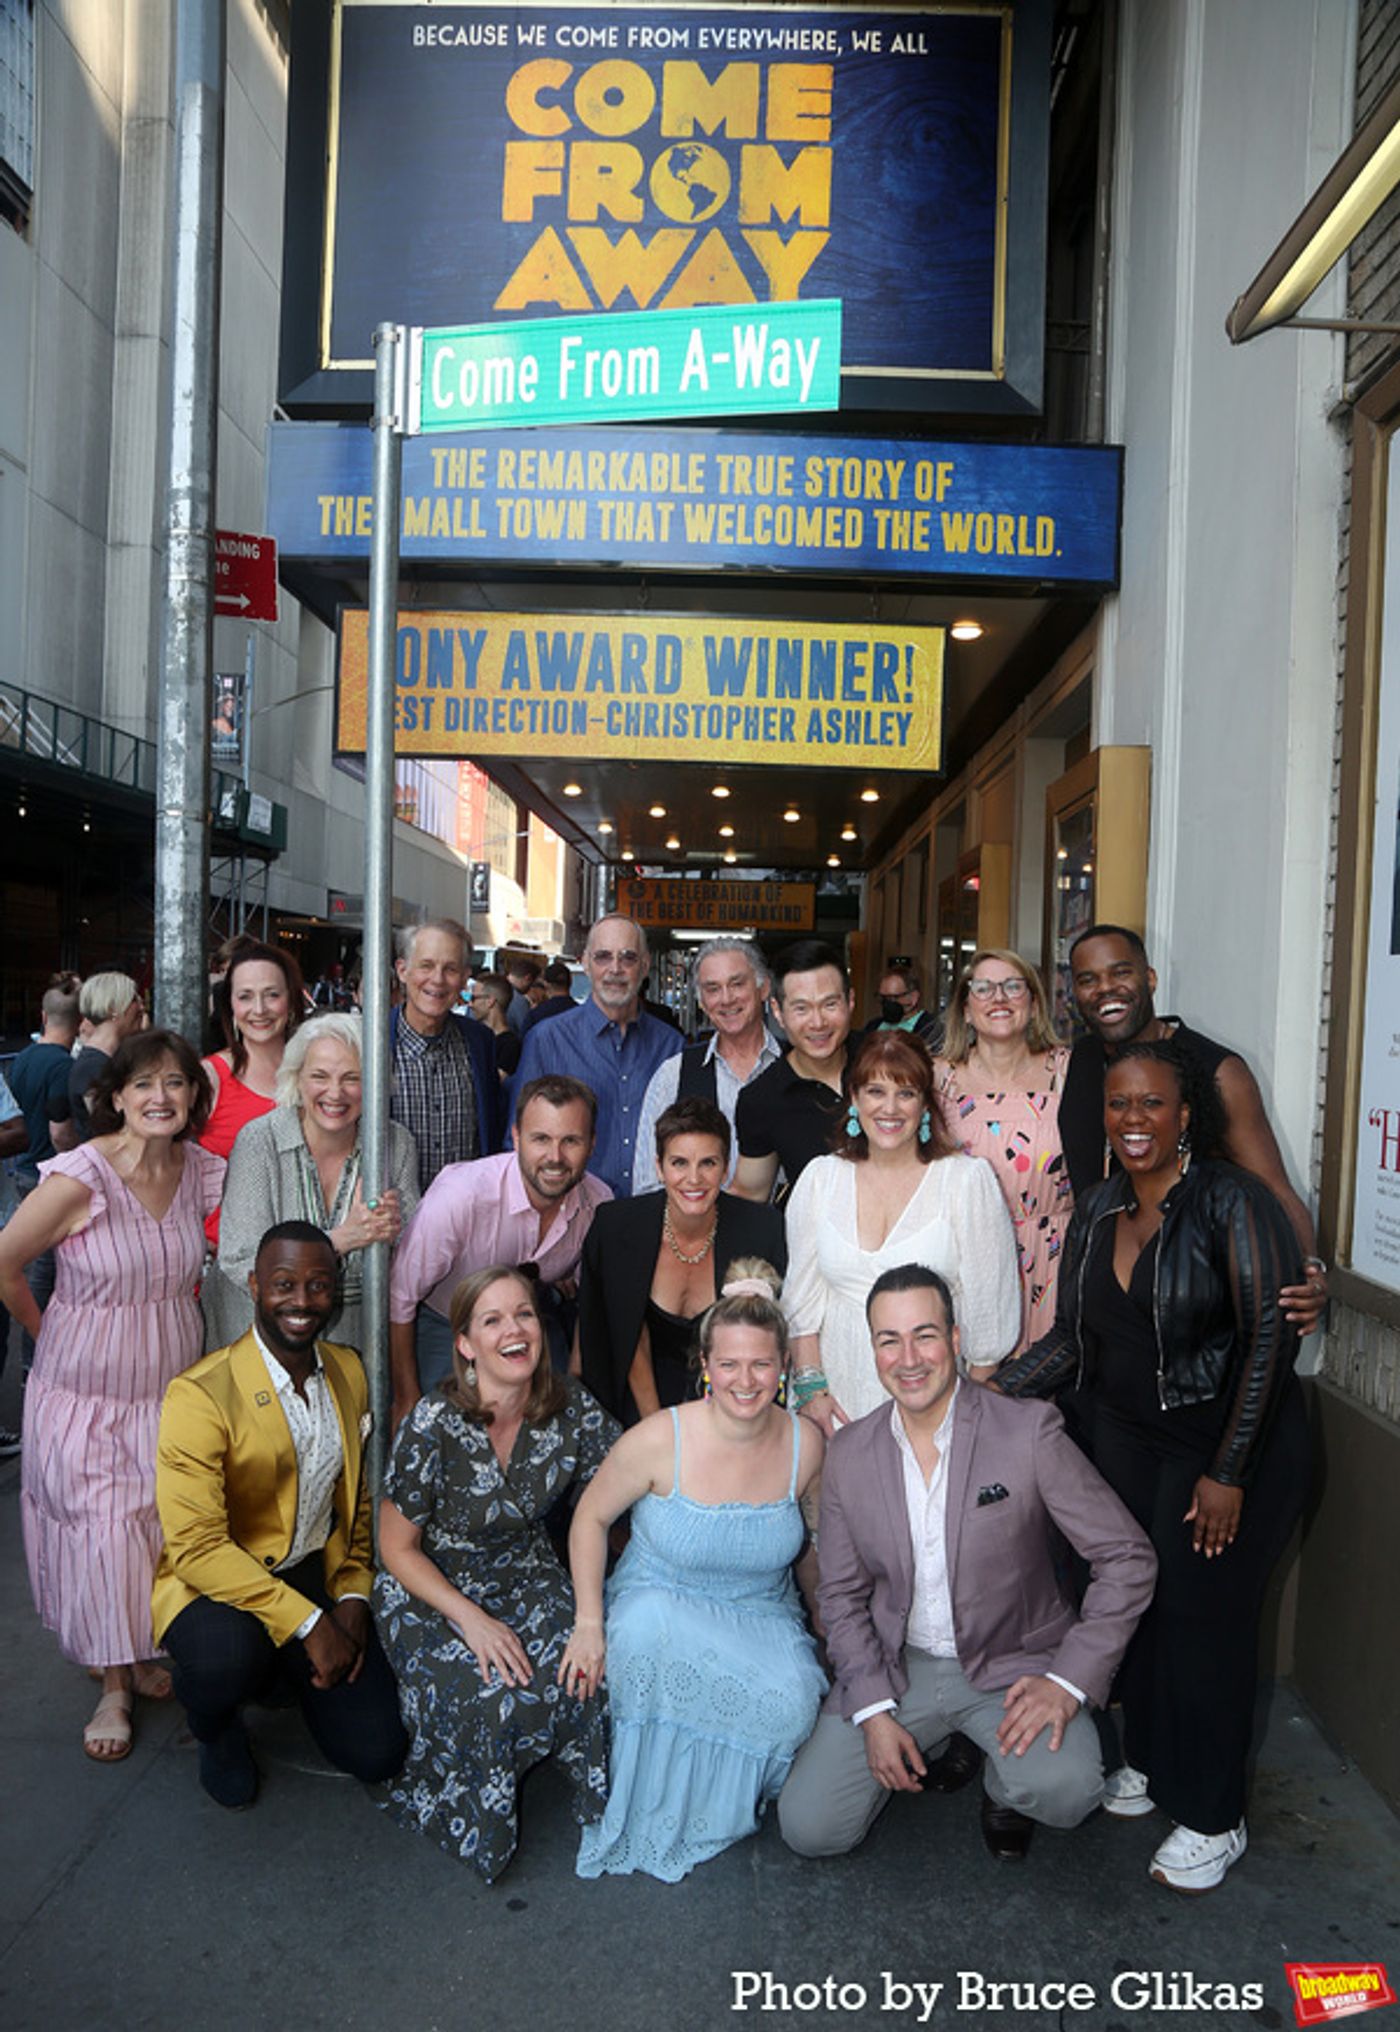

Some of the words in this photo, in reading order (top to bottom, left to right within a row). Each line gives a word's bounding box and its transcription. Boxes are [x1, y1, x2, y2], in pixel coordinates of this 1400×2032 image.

[412, 24, 508, 46] BECAUSE
[517, 25, 547, 46] WE
[555, 25, 619, 48] COME
[627, 27, 689, 48] FROM
[698, 27, 842, 56] EVERYWHERE,
[851, 30, 882, 52] WE
[890, 33, 928, 54] ALL
[505, 57, 834, 141] COME
[502, 140, 833, 227] FROM
[493, 225, 831, 310] AWAY
[432, 346, 539, 409] Come
[560, 336, 659, 400] From
[679, 324, 820, 403] A-Way
[431, 448, 487, 489] THE
[497, 449, 706, 494] REMARKABLE
[716, 455, 794, 497] TRUE
[805, 456, 906, 500] STORY
[914, 462, 954, 502] OF
[318, 496, 373, 536] THE
[403, 497, 487, 538] MALL
[496, 500, 587, 540] TOWN
[598, 502, 675, 543] THAT
[684, 504, 863, 549] WELCOMED
[873, 509, 930, 552] THE
[941, 511, 1062, 557] WORLD.
[395, 626, 488, 689] ONY
[703, 635, 915, 704] WINNER!
[806, 706, 913, 747] ASHLEY
[658, 902, 692, 919] BEST
